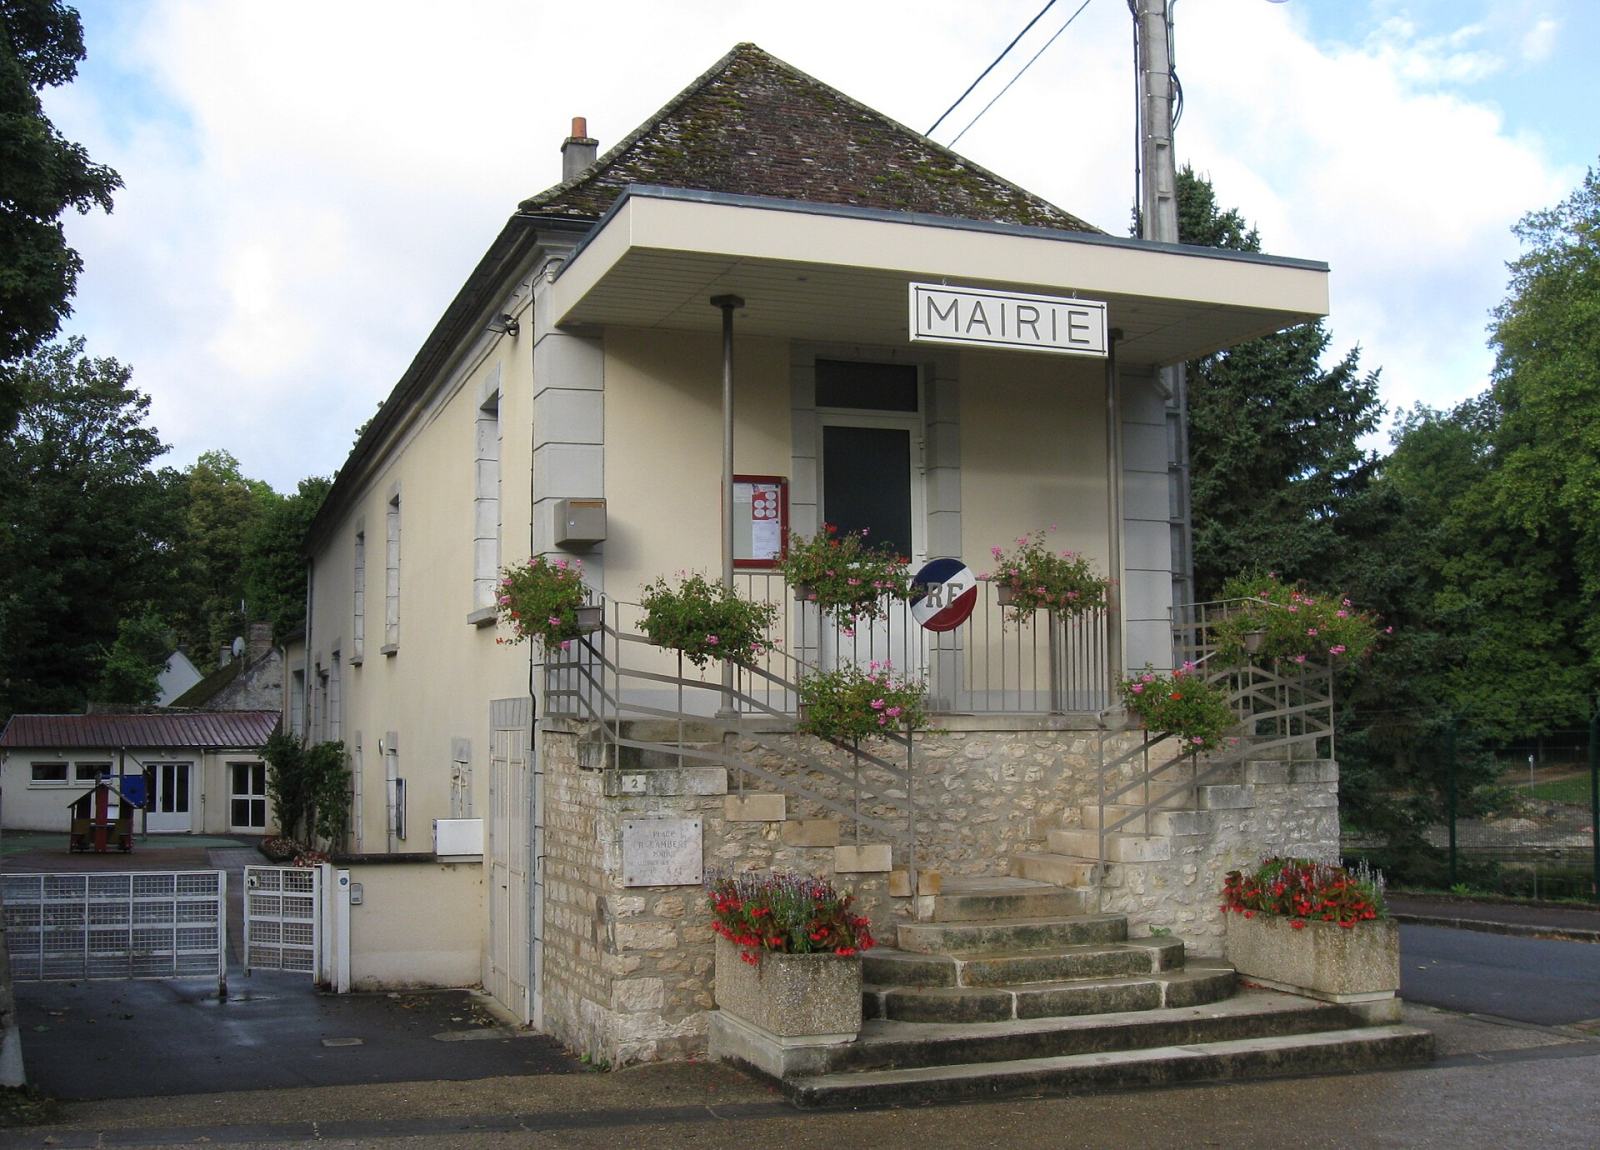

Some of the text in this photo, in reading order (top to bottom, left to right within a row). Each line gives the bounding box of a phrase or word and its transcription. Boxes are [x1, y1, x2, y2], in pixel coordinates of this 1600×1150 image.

[927, 295, 1090, 344] MAIRIE
[926, 582, 964, 608] RF
[631, 778, 639, 788] 2
